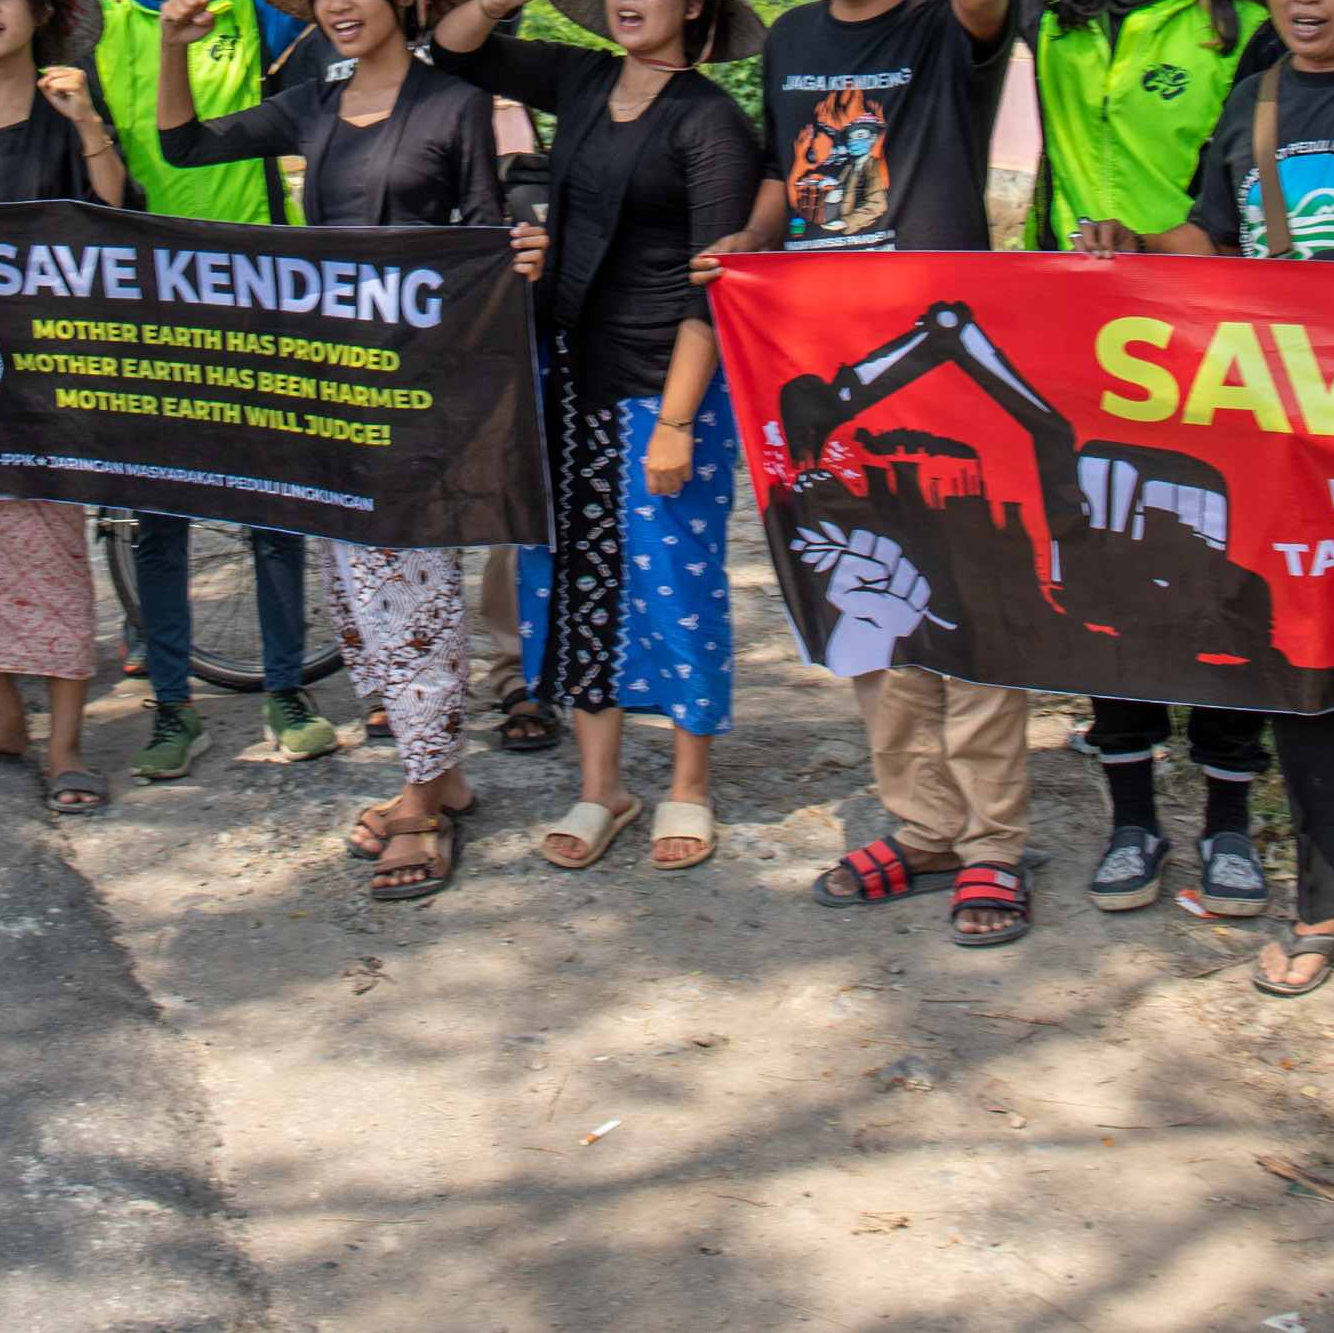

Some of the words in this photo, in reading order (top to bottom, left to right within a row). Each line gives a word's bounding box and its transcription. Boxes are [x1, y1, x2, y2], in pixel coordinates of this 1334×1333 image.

[153, 249, 444, 328] KENDENG
[32, 319, 139, 343] MOTHER
[141, 324, 223, 350] EARTH
[225, 331, 276, 356] HAS
[278, 336, 401, 372] PROVIDED
[12, 353, 119, 377] MOTHER
[121, 358, 202, 384] EARTH
[205, 366, 255, 390] HAS
[257, 371, 317, 399] BEEN
[319, 380, 434, 409] HARMED
[55, 388, 159, 415] MOTHER
[161, 397, 242, 424] EARTH
[244, 405, 304, 433] WILL
[304, 415, 391, 446] JUDGE!
